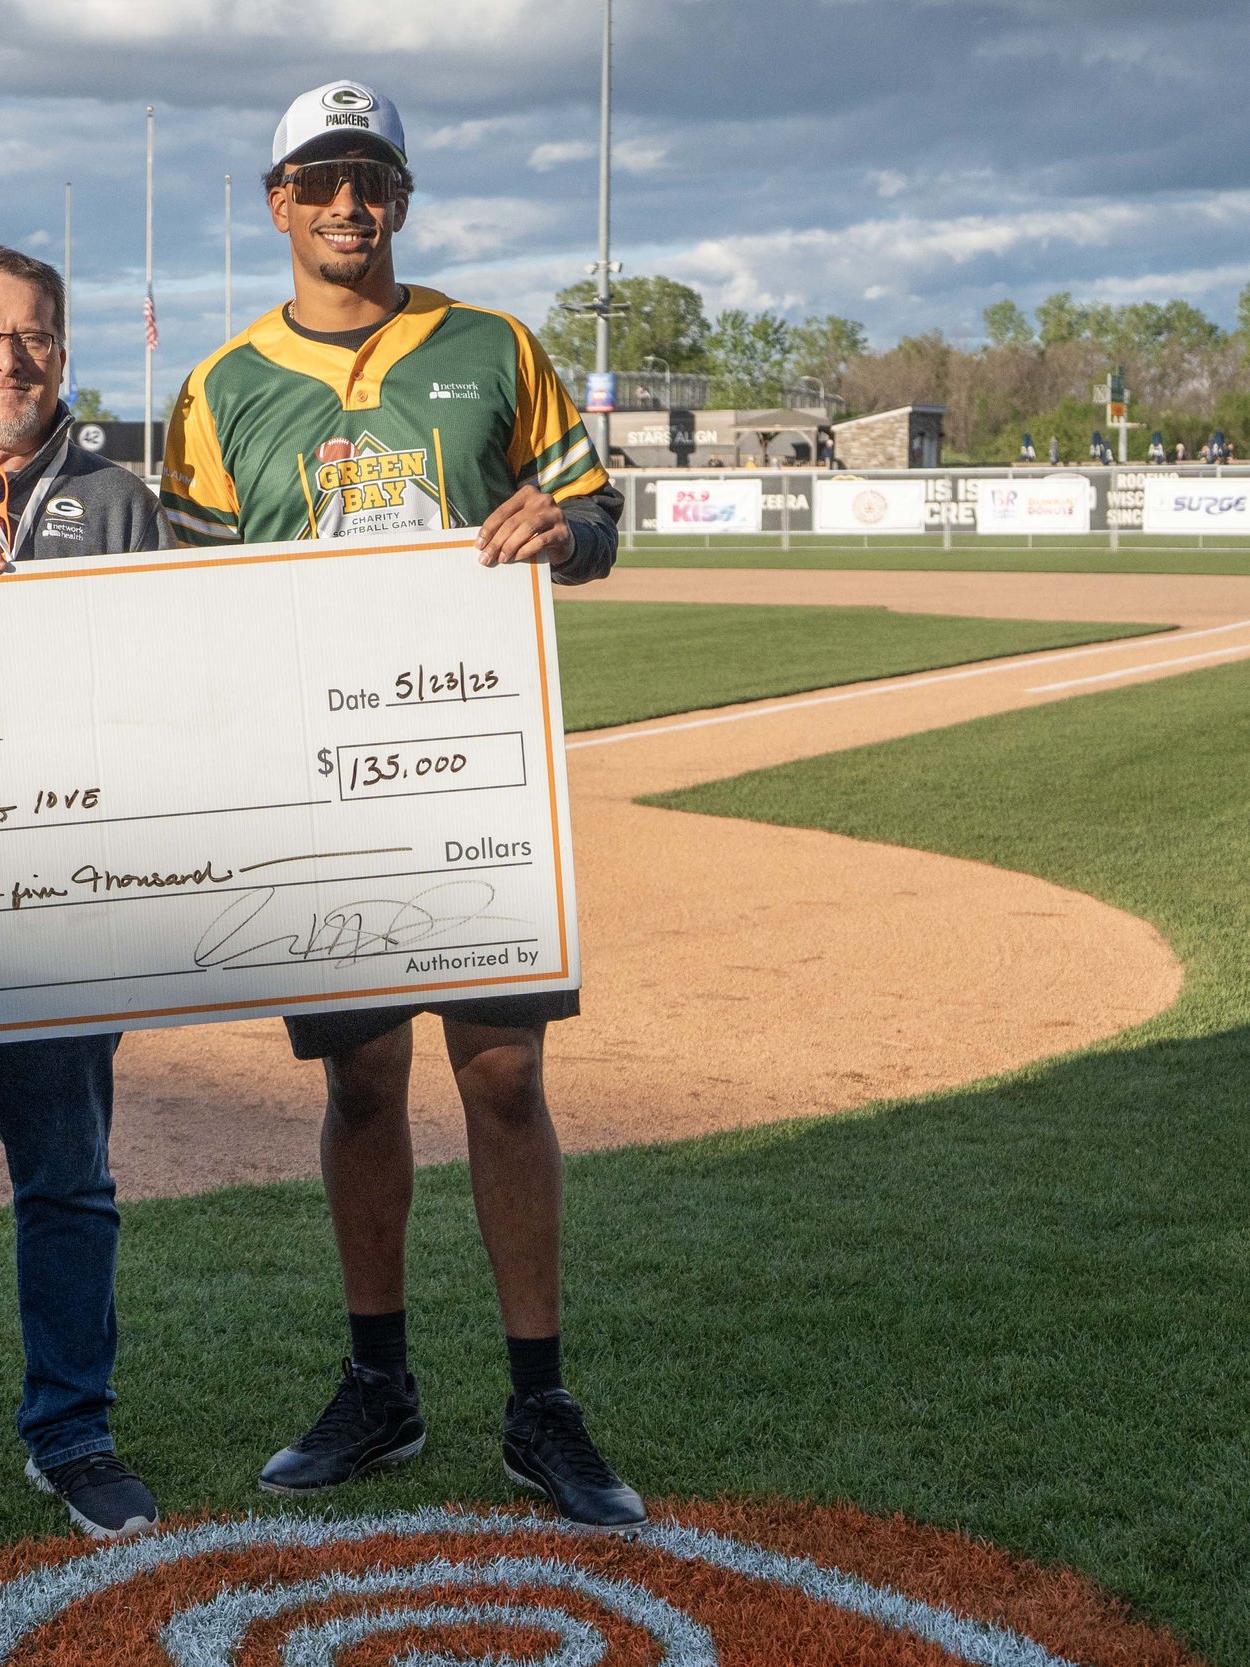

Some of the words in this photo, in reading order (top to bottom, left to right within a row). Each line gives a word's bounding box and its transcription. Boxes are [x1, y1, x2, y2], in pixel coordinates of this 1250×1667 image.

[326, 113, 369, 129] PACKERS
[440, 381, 479, 391] network
[451, 390, 480, 400] health
[83, 430, 100, 445] 42
[627, 431, 671, 446] STARS
[673, 431, 718, 446] ALGN
[317, 450, 426, 490] GREEN
[341, 479, 407, 516] BAY
[676, 490, 710, 502] 95.9
[925, 501, 977, 524] CRE
[1172, 496, 1247, 515] SURGE
[352, 512, 400, 525] CHARITY
[52, 522, 84, 534] network
[60, 530, 84, 541] health
[332, 521, 389, 538] SOFTBALL
[392, 518, 425, 529] GAME
[328, 688, 381, 711] Date
[394, 661, 500, 703] 5/23/25
[317, 747, 335, 777] $
[445, 838, 533, 863] Dollars
[405, 951, 510, 974] Authorized
[518, 948, 539, 967] by
